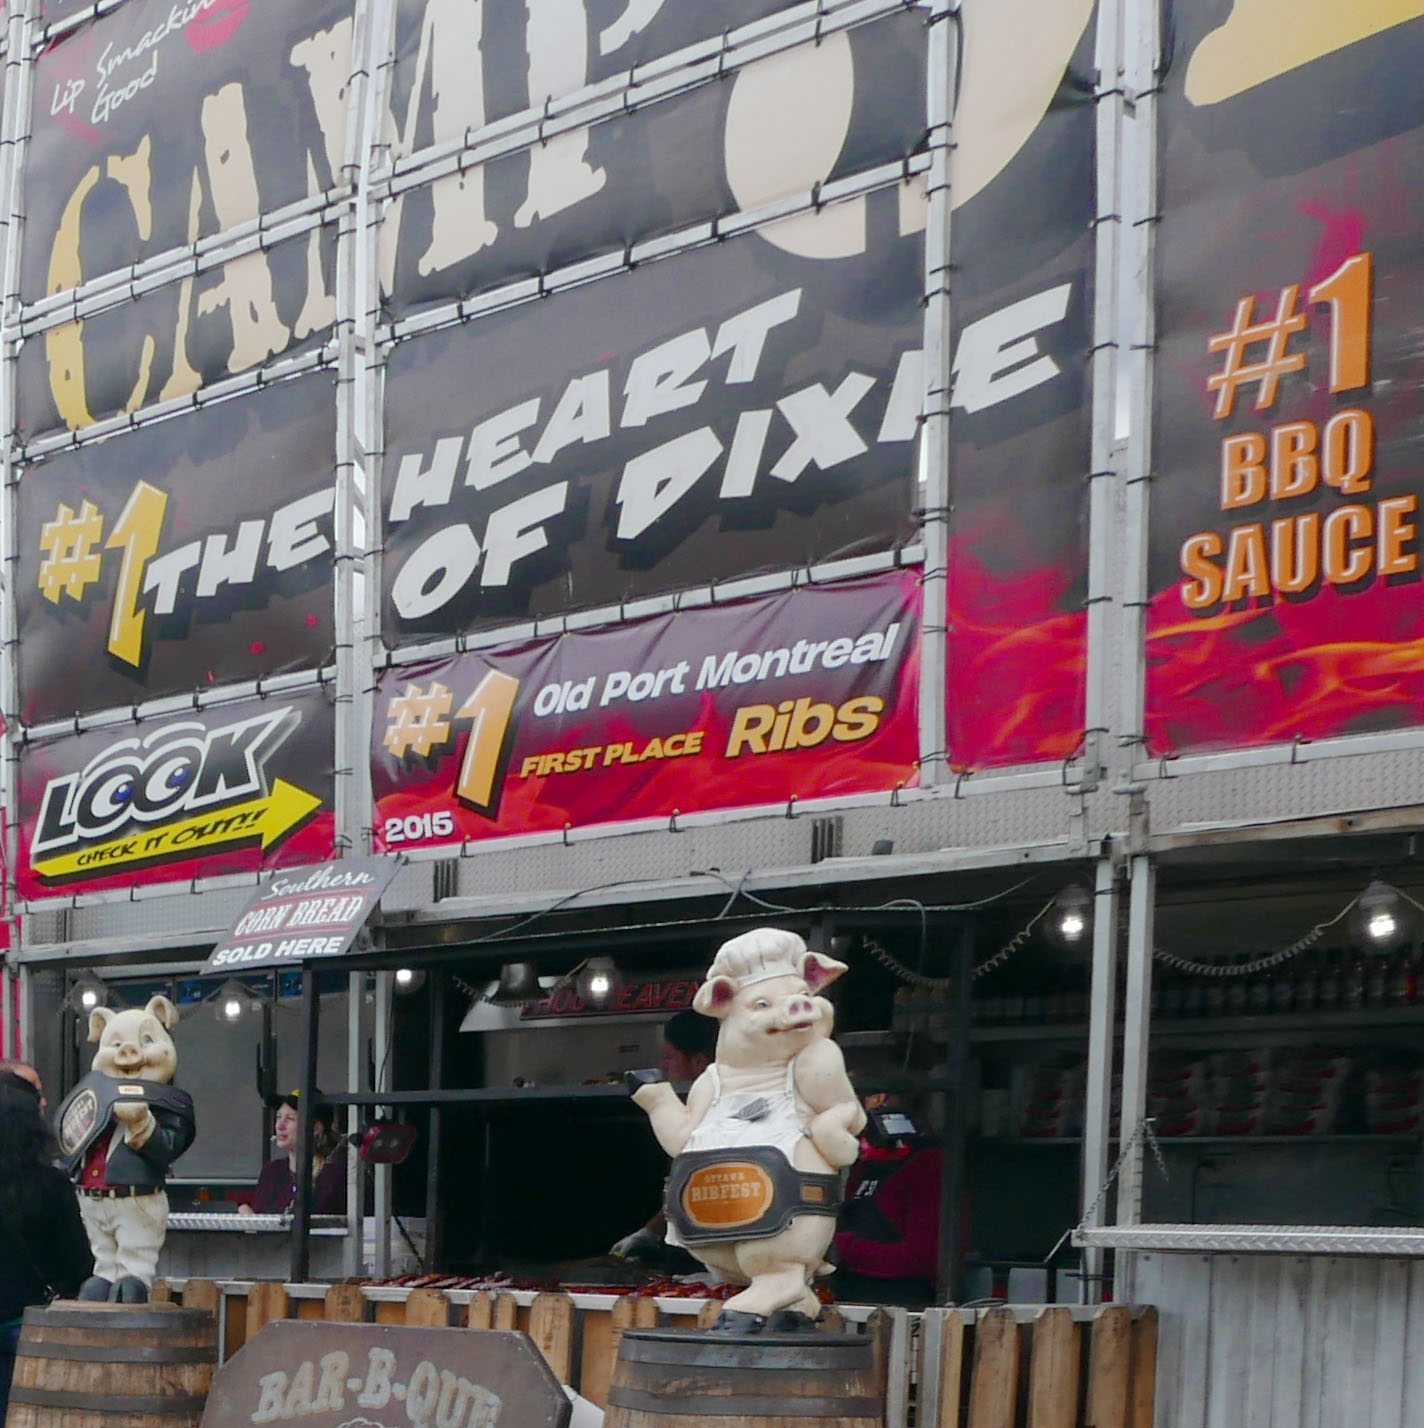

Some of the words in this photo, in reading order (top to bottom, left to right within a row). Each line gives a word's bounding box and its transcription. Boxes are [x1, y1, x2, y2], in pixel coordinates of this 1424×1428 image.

[51, 79, 86, 116] Lip
[91, 51, 158, 125] Good
[1207, 252, 1373, 419] #1
[390, 289, 803, 522] HEART
[392, 481, 568, 619] OF
[617, 284, 1071, 540] DIXIE
[1219, 410, 1373, 511] BBQ
[39, 480, 167, 667] #1
[145, 487, 335, 614] THE
[1180, 496, 1418, 611] SAUCE
[532, 675, 596, 717] Old
[600, 661, 690, 708] Port
[694, 623, 901, 692] Montreal
[30, 706, 295, 853] LOOK
[382, 668, 520, 808] #1
[519, 744, 601, 779] FIRST
[603, 730, 704, 768] PLACE
[725, 694, 887, 758] Ribs
[77, 841, 138, 866] CHECK
[145, 833, 169, 850] IT
[384, 810, 454, 844] 2015
[234, 904, 293, 936] CORN
[285, 896, 364, 928] BREAD
[261, 865, 375, 900] Southern
[212, 943, 273, 966] SOLD
[274, 936, 345, 957] HERE
[692, 1182, 762, 1202] RIBFEST
